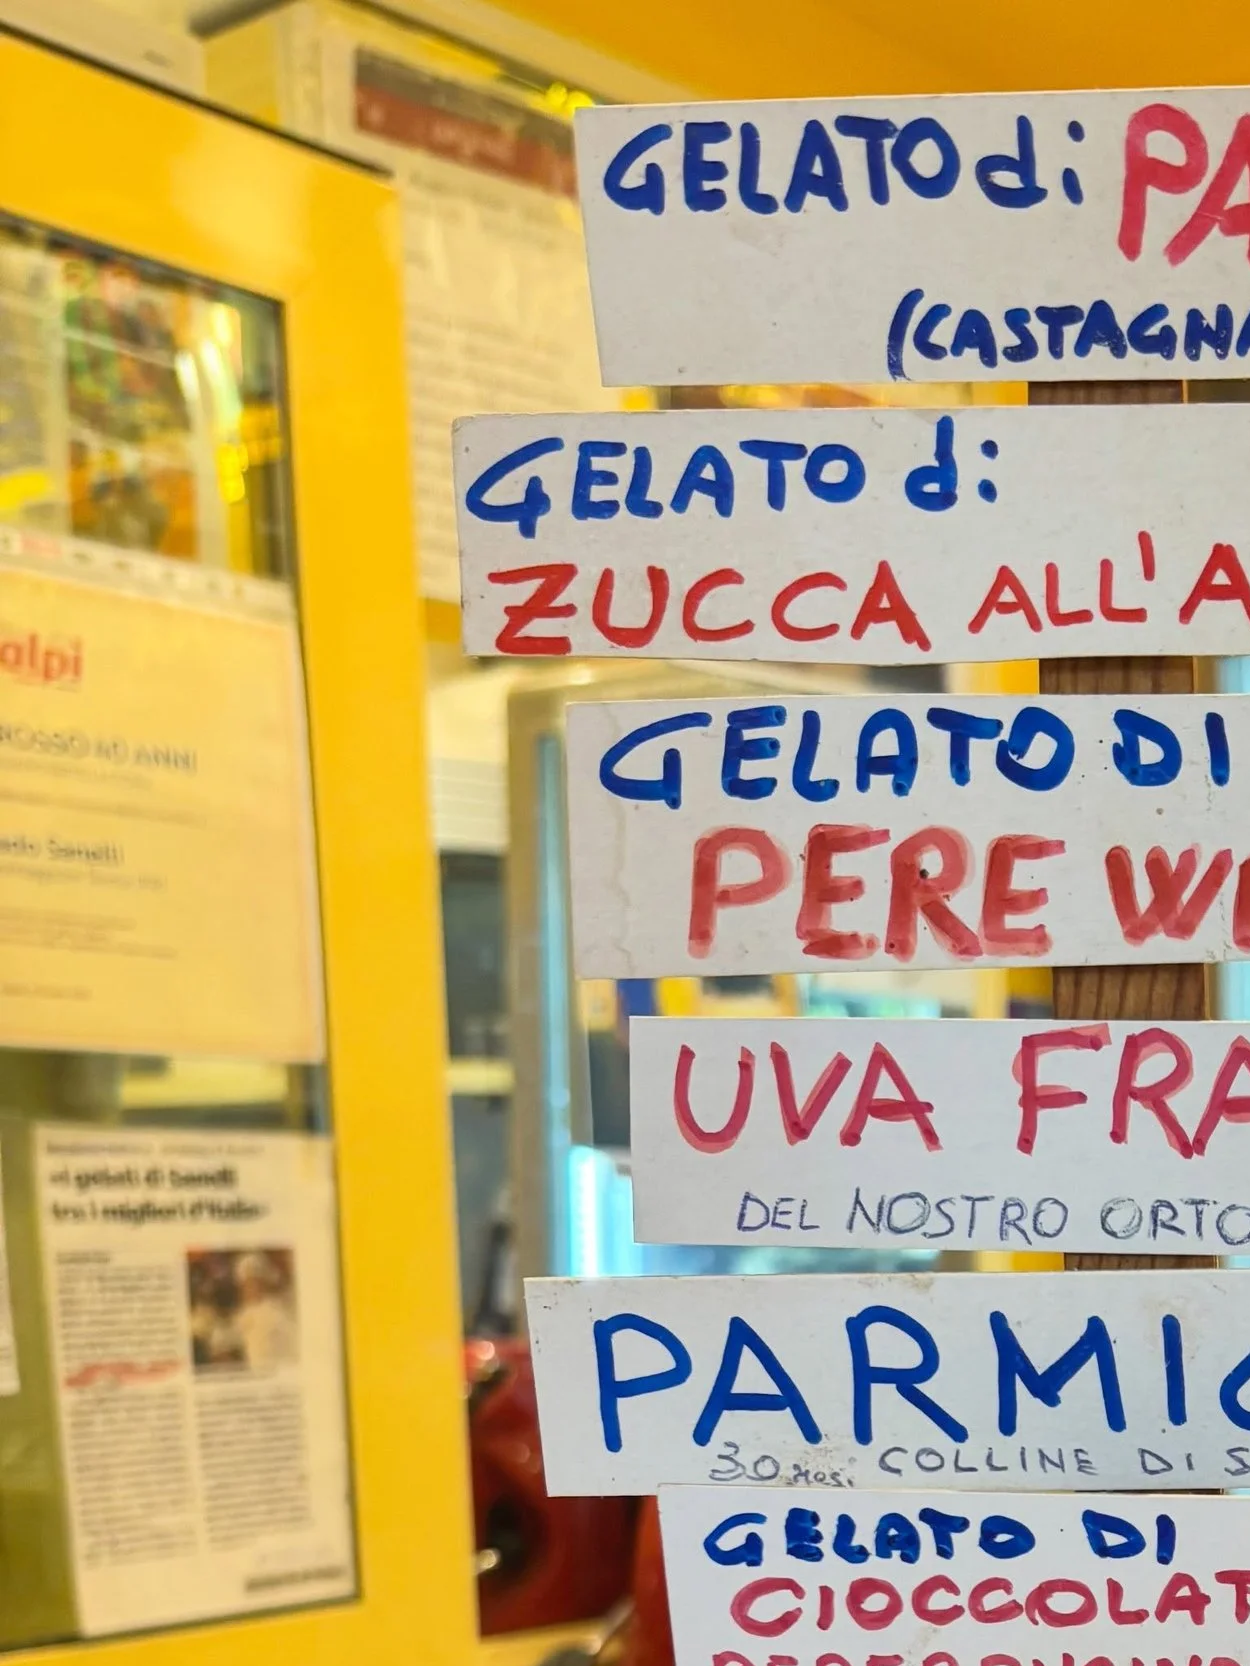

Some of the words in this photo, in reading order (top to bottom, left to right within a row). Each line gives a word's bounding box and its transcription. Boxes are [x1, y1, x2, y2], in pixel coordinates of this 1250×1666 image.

[603, 114, 961, 215] GELATO
[975, 114, 1083, 209] di
[465, 436, 866, 539] GELATO
[487, 559, 932, 655] ZUCCA
[599, 705, 1076, 811] GELATO
[1112, 708, 1230, 788] DI
[688, 823, 1068, 963] PERE
[672, 1039, 946, 1154] UVA
[736, 1191, 820, 1236] DEL
[846, 1186, 1068, 1241] NOSTRO
[708, 1441, 780, 1482] 30
[878, 1446, 1100, 1477] COLLINE
[1139, 1448, 1194, 1475] DI
[702, 1506, 1038, 1567] GELATO
[1082, 1507, 1178, 1566] DI
